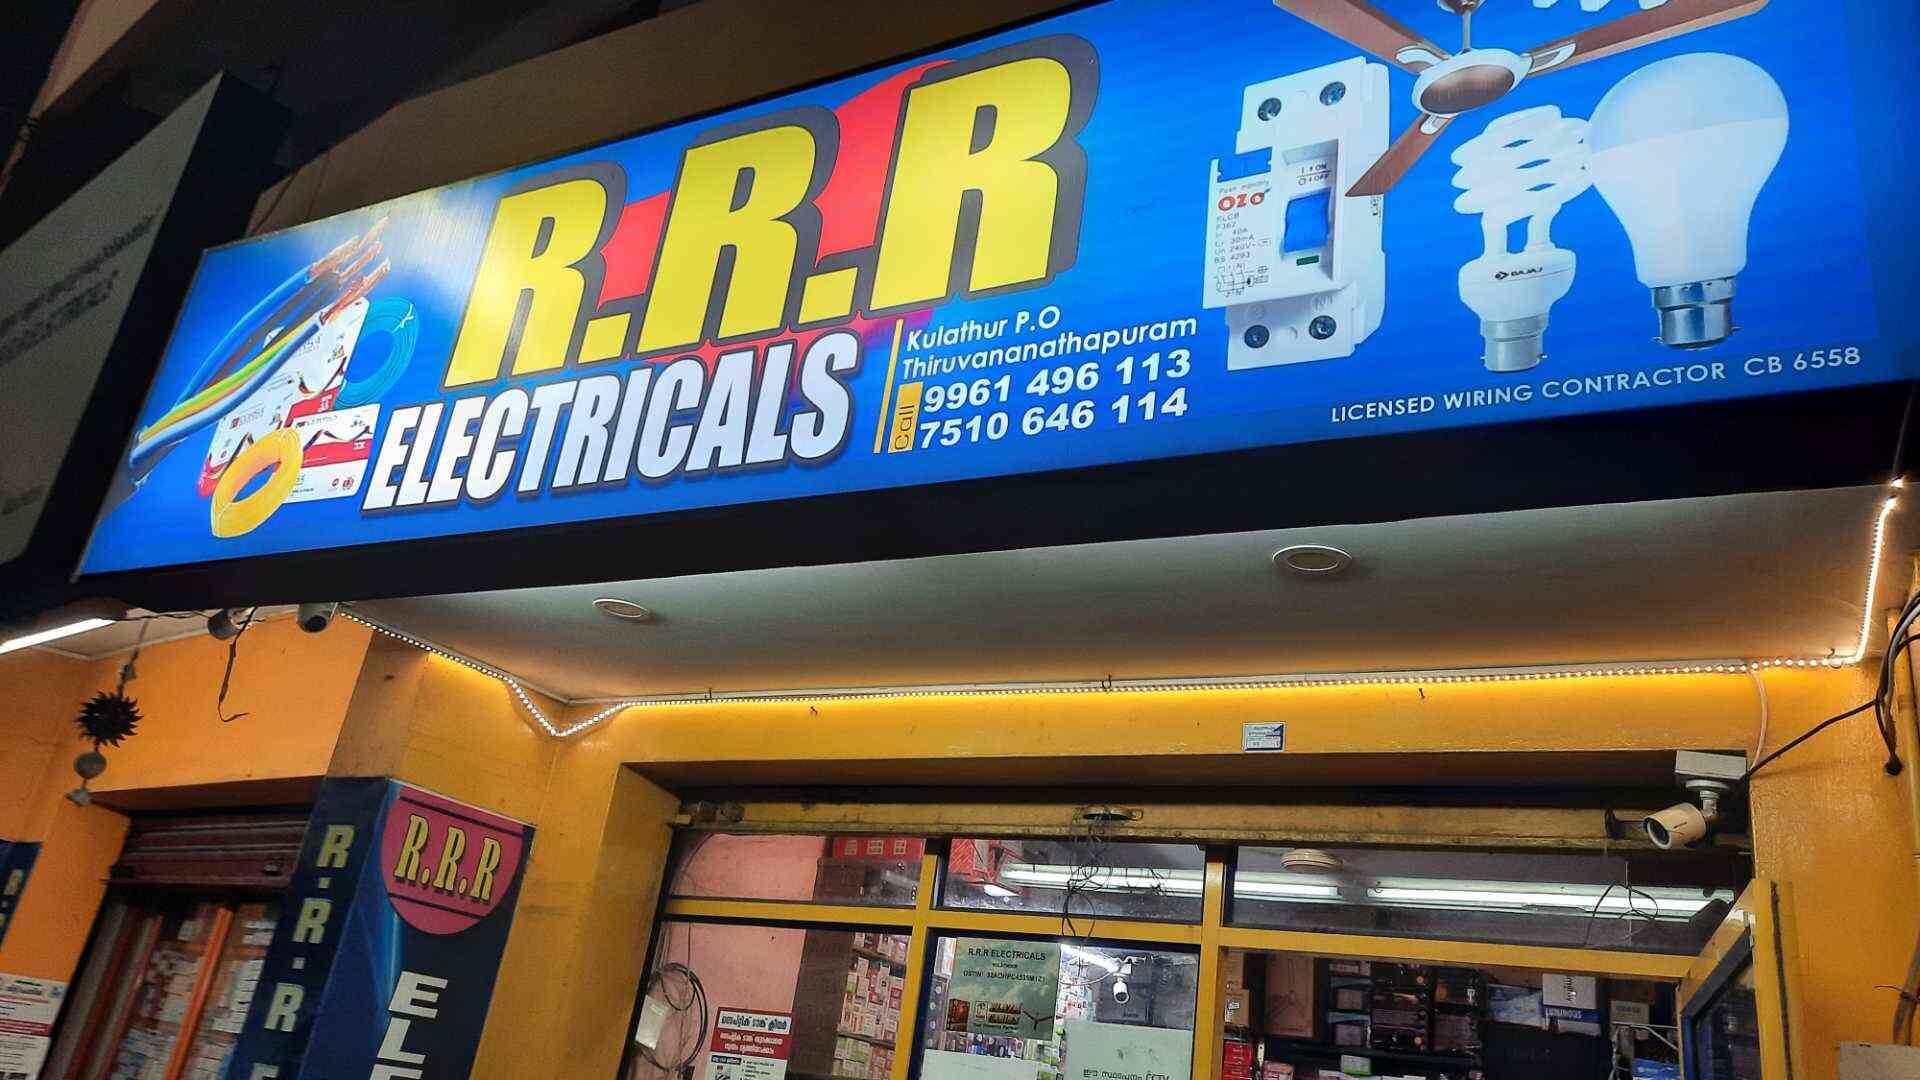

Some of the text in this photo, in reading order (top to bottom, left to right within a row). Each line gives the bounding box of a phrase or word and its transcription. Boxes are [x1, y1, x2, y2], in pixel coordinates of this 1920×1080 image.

[444, 56, 1073, 389] R.R.R
[903, 317, 1197, 380] Thiruvananathapuram
[906, 305, 1062, 352] Kulathur P.O
[922, 348, 1192, 413] 9961 496 113
[1330, 345, 1861, 423] LICENSED WIRING CONTRACTOR CB 6558
[362, 332, 860, 512] ELECTRICALS
[893, 404, 916, 450] Call
[919, 387, 1189, 450] 7510 646 114
[393, 813, 502, 901] R.R.R
[990, 949, 1047, 961] ELECTRICALS
